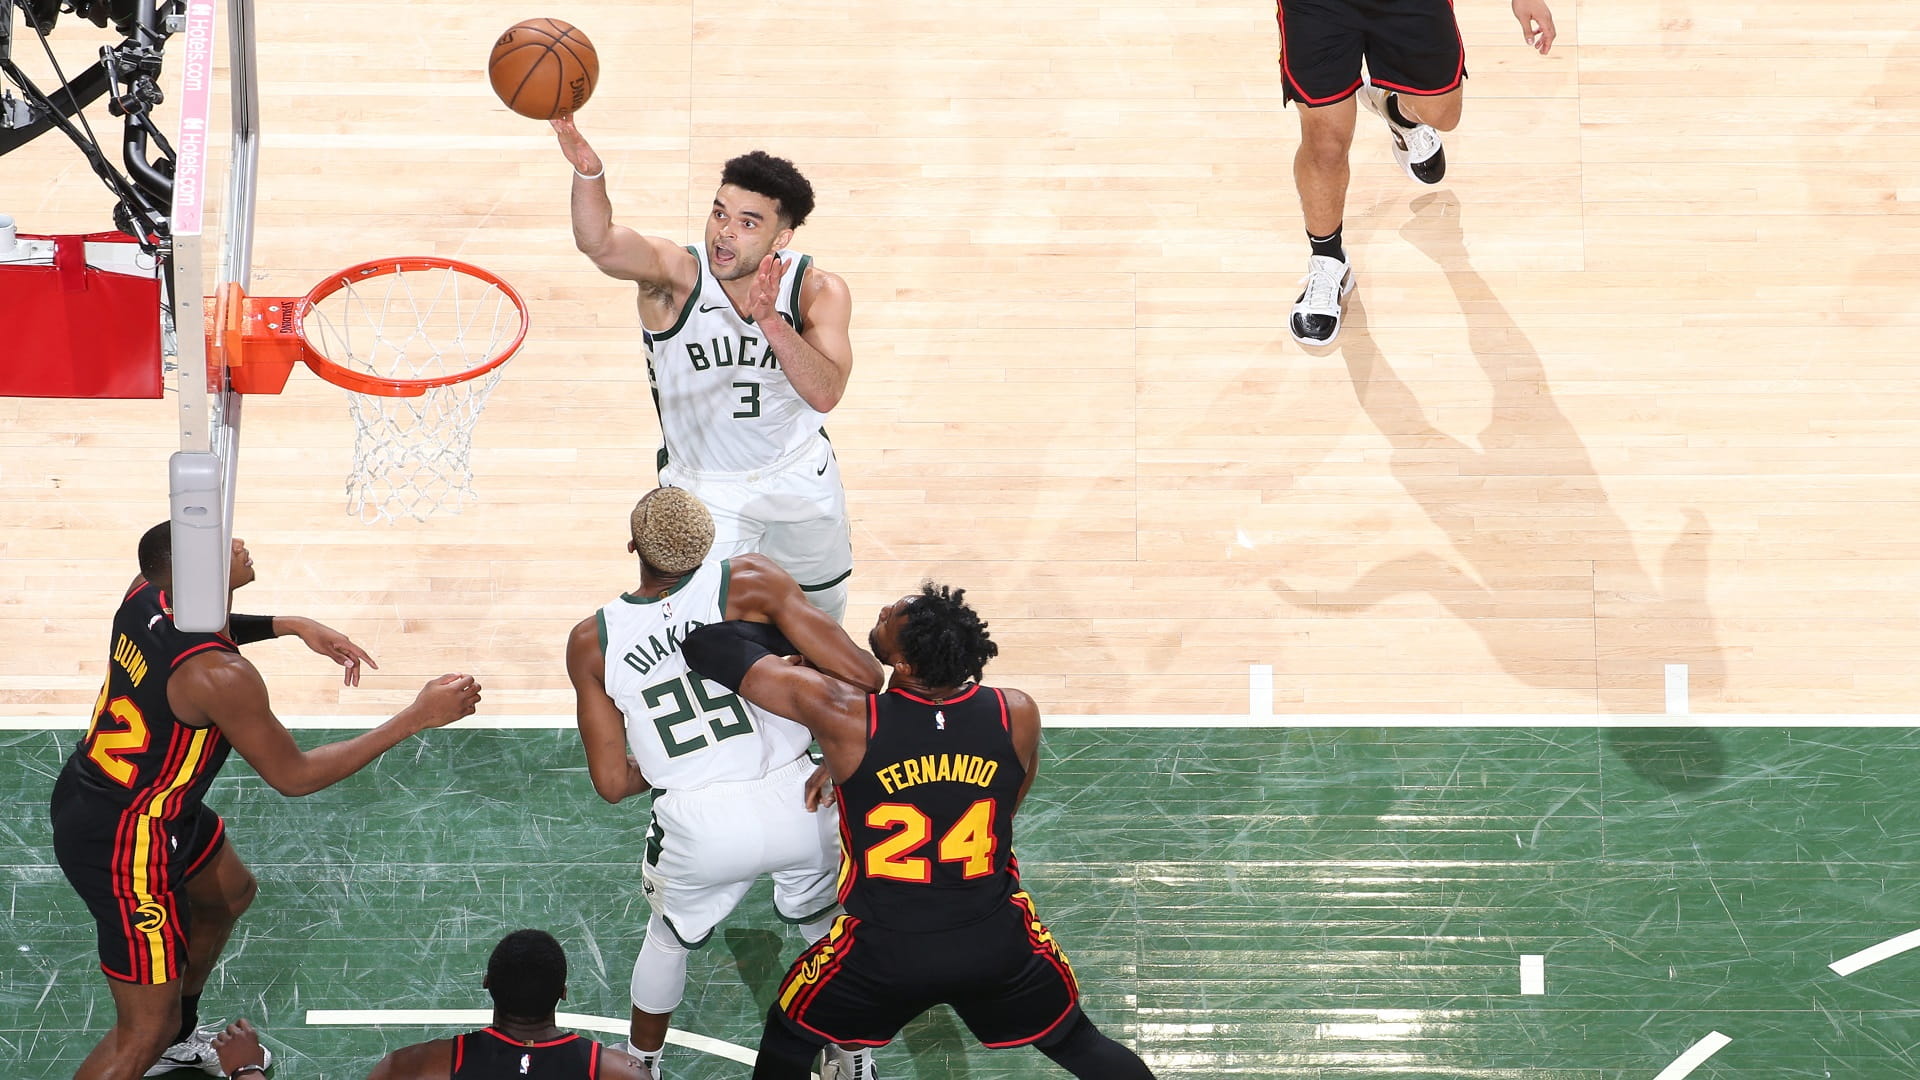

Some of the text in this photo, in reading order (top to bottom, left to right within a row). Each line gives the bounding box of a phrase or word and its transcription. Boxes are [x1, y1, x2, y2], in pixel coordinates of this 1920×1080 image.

[185, 19, 209, 91] Hotels.com
[177, 133, 202, 206] Hotels.com
[280, 302, 294, 334] SPALDING
[685, 335, 783, 372] BUCK
[732, 382, 761, 419] 3
[113, 633, 148, 688] DUNN
[641, 671, 754, 759] 25
[876, 753, 998, 795] FERNANDO
[865, 797, 997, 884] 24
